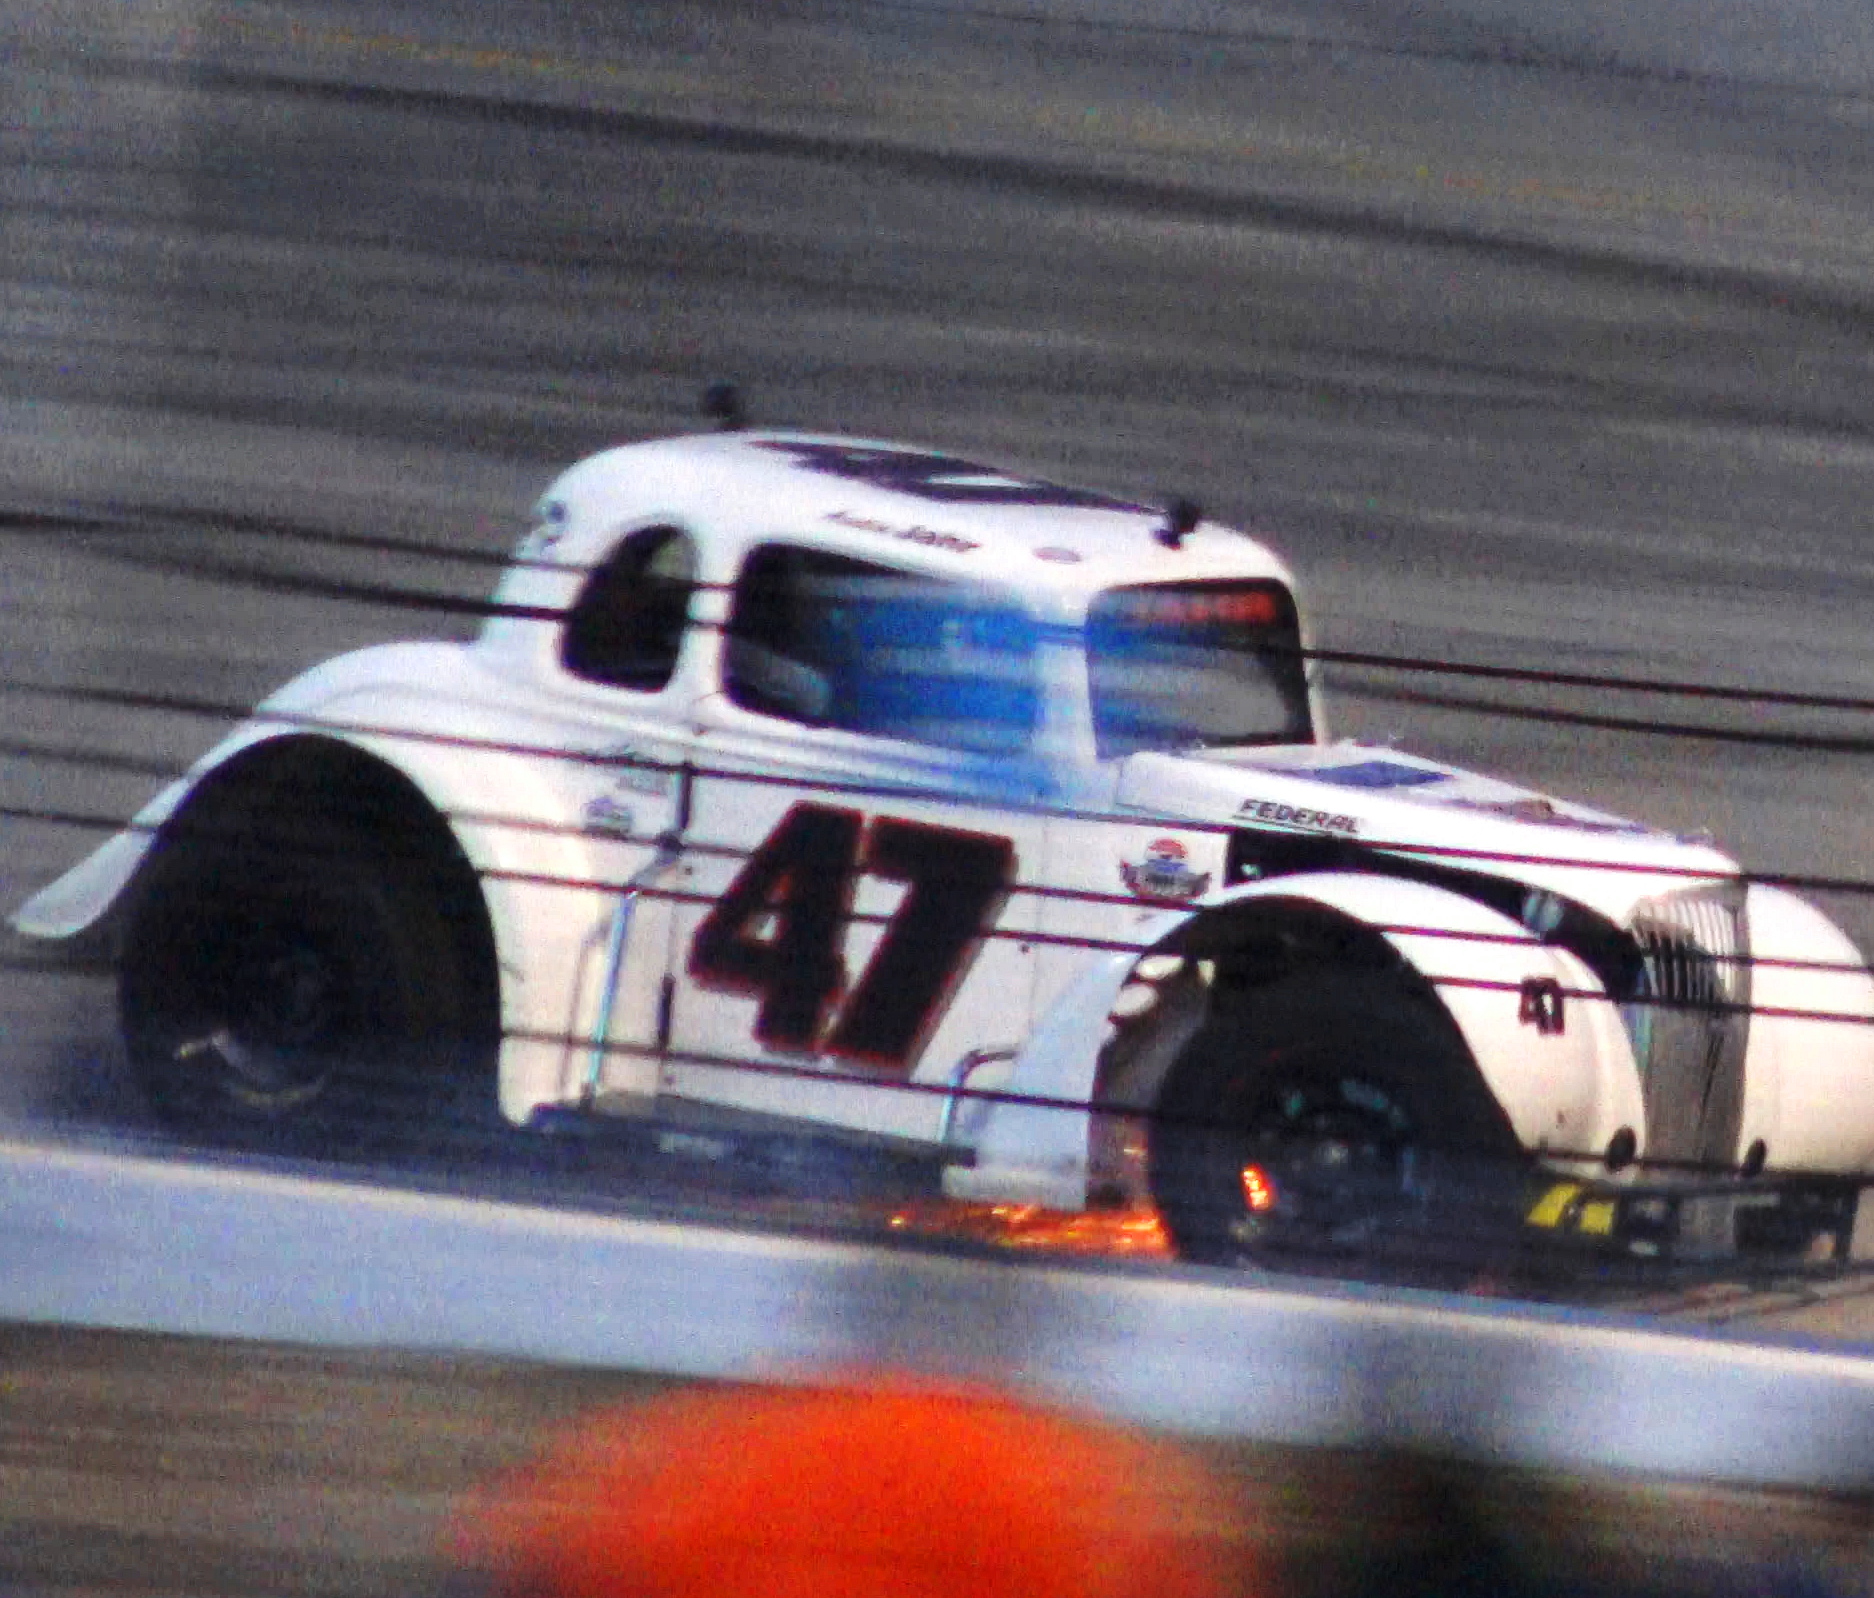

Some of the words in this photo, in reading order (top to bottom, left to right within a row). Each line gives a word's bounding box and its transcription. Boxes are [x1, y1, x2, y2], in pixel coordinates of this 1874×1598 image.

[1239, 798, 1360, 834] FEDERAL
[688, 799, 1017, 1076] 47
[1518, 976, 1564, 1036] 47
